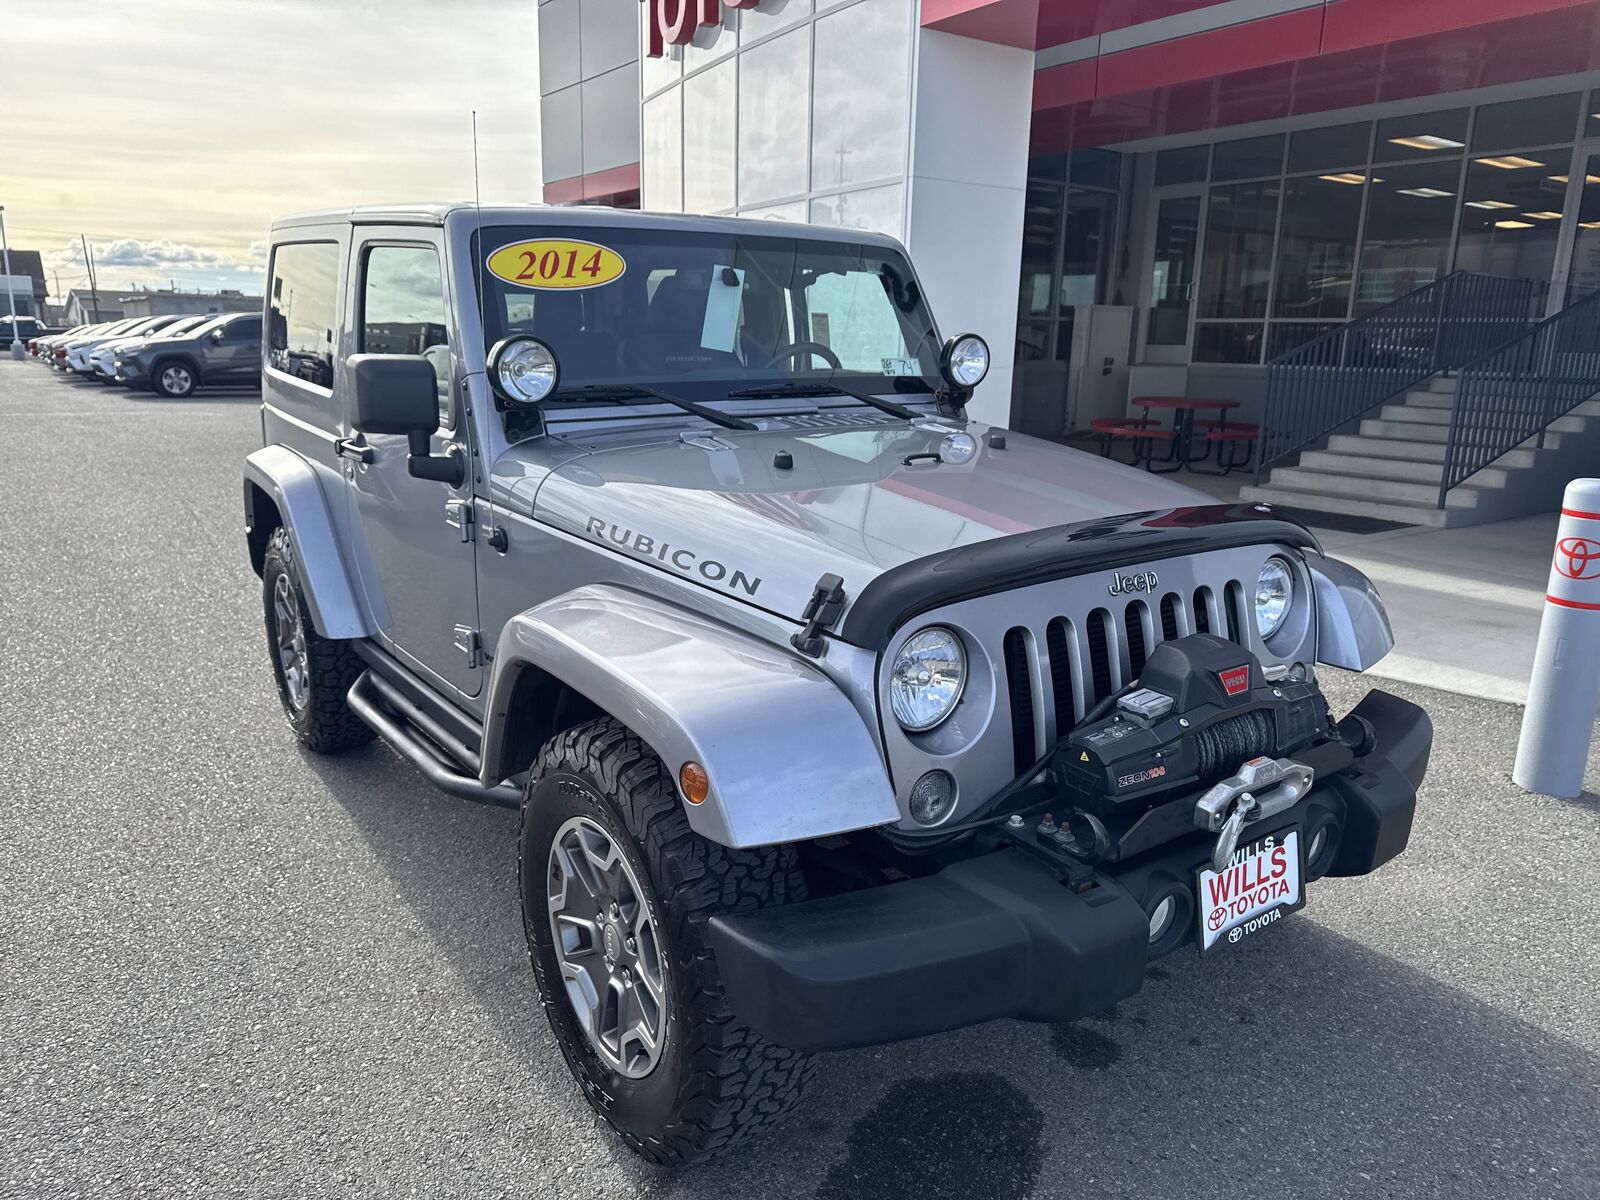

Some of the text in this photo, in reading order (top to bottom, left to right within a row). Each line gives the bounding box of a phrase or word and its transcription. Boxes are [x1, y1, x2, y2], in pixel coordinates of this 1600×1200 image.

[515, 249, 603, 280] 2014
[585, 516, 762, 596] RUBICON
[1108, 571, 1158, 596] Jeep
[1208, 847, 1287, 907] WILLS
[1228, 879, 1290, 920] TOYOTA
[1244, 908, 1282, 934] TOYOTA
